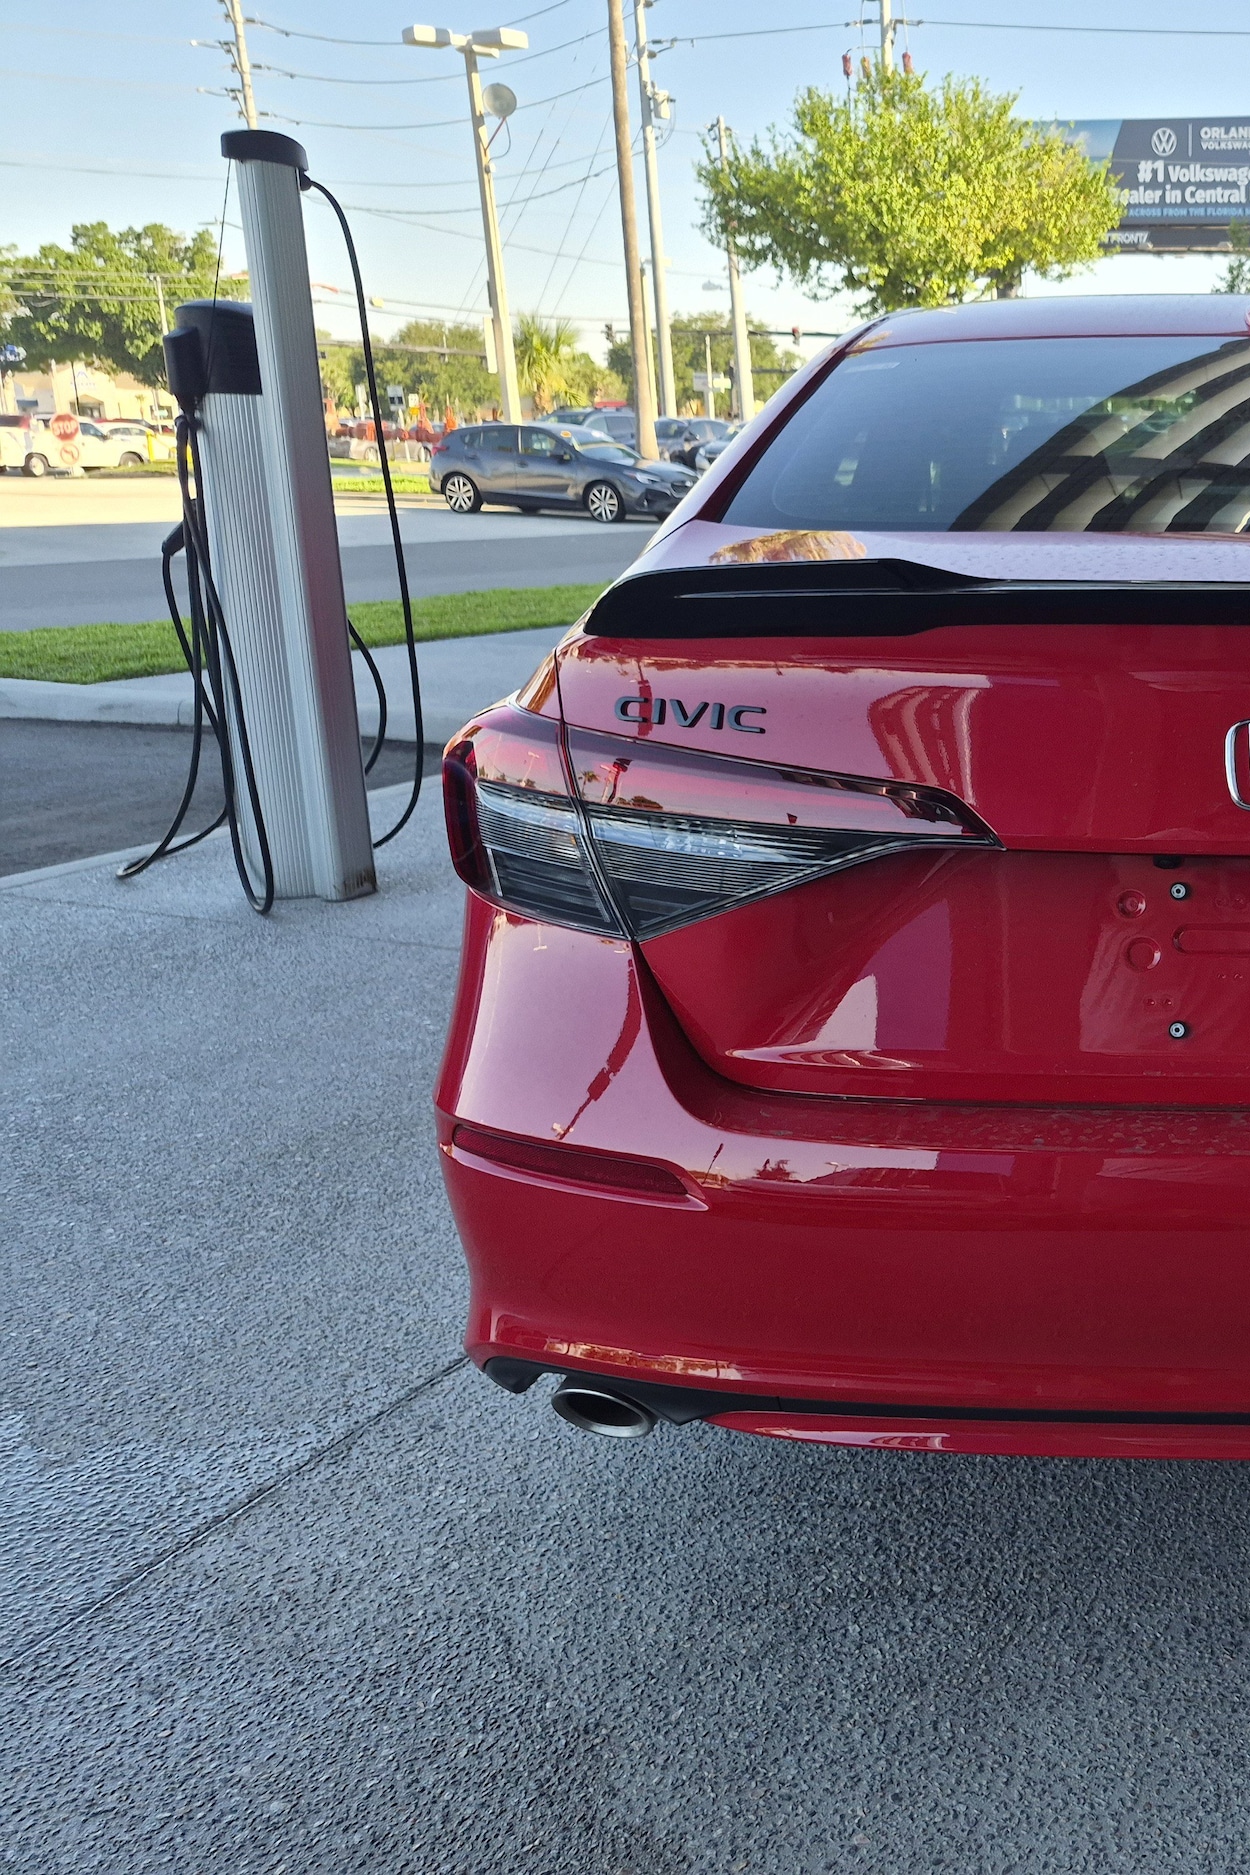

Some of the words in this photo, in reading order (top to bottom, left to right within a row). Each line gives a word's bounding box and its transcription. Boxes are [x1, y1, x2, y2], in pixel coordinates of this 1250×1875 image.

[1137, 160, 1164, 183] #1
[1165, 184, 1181, 204] in
[1185, 185, 1247, 204] Central
[1128, 208, 1161, 217] ACROSS
[1163, 208, 1187, 217] FROM
[1189, 207, 1206, 217] THE
[1207, 207, 1243, 217] FLORIDA
[52, 419, 77, 436] STOP
[614, 695, 768, 734] CIVIC
